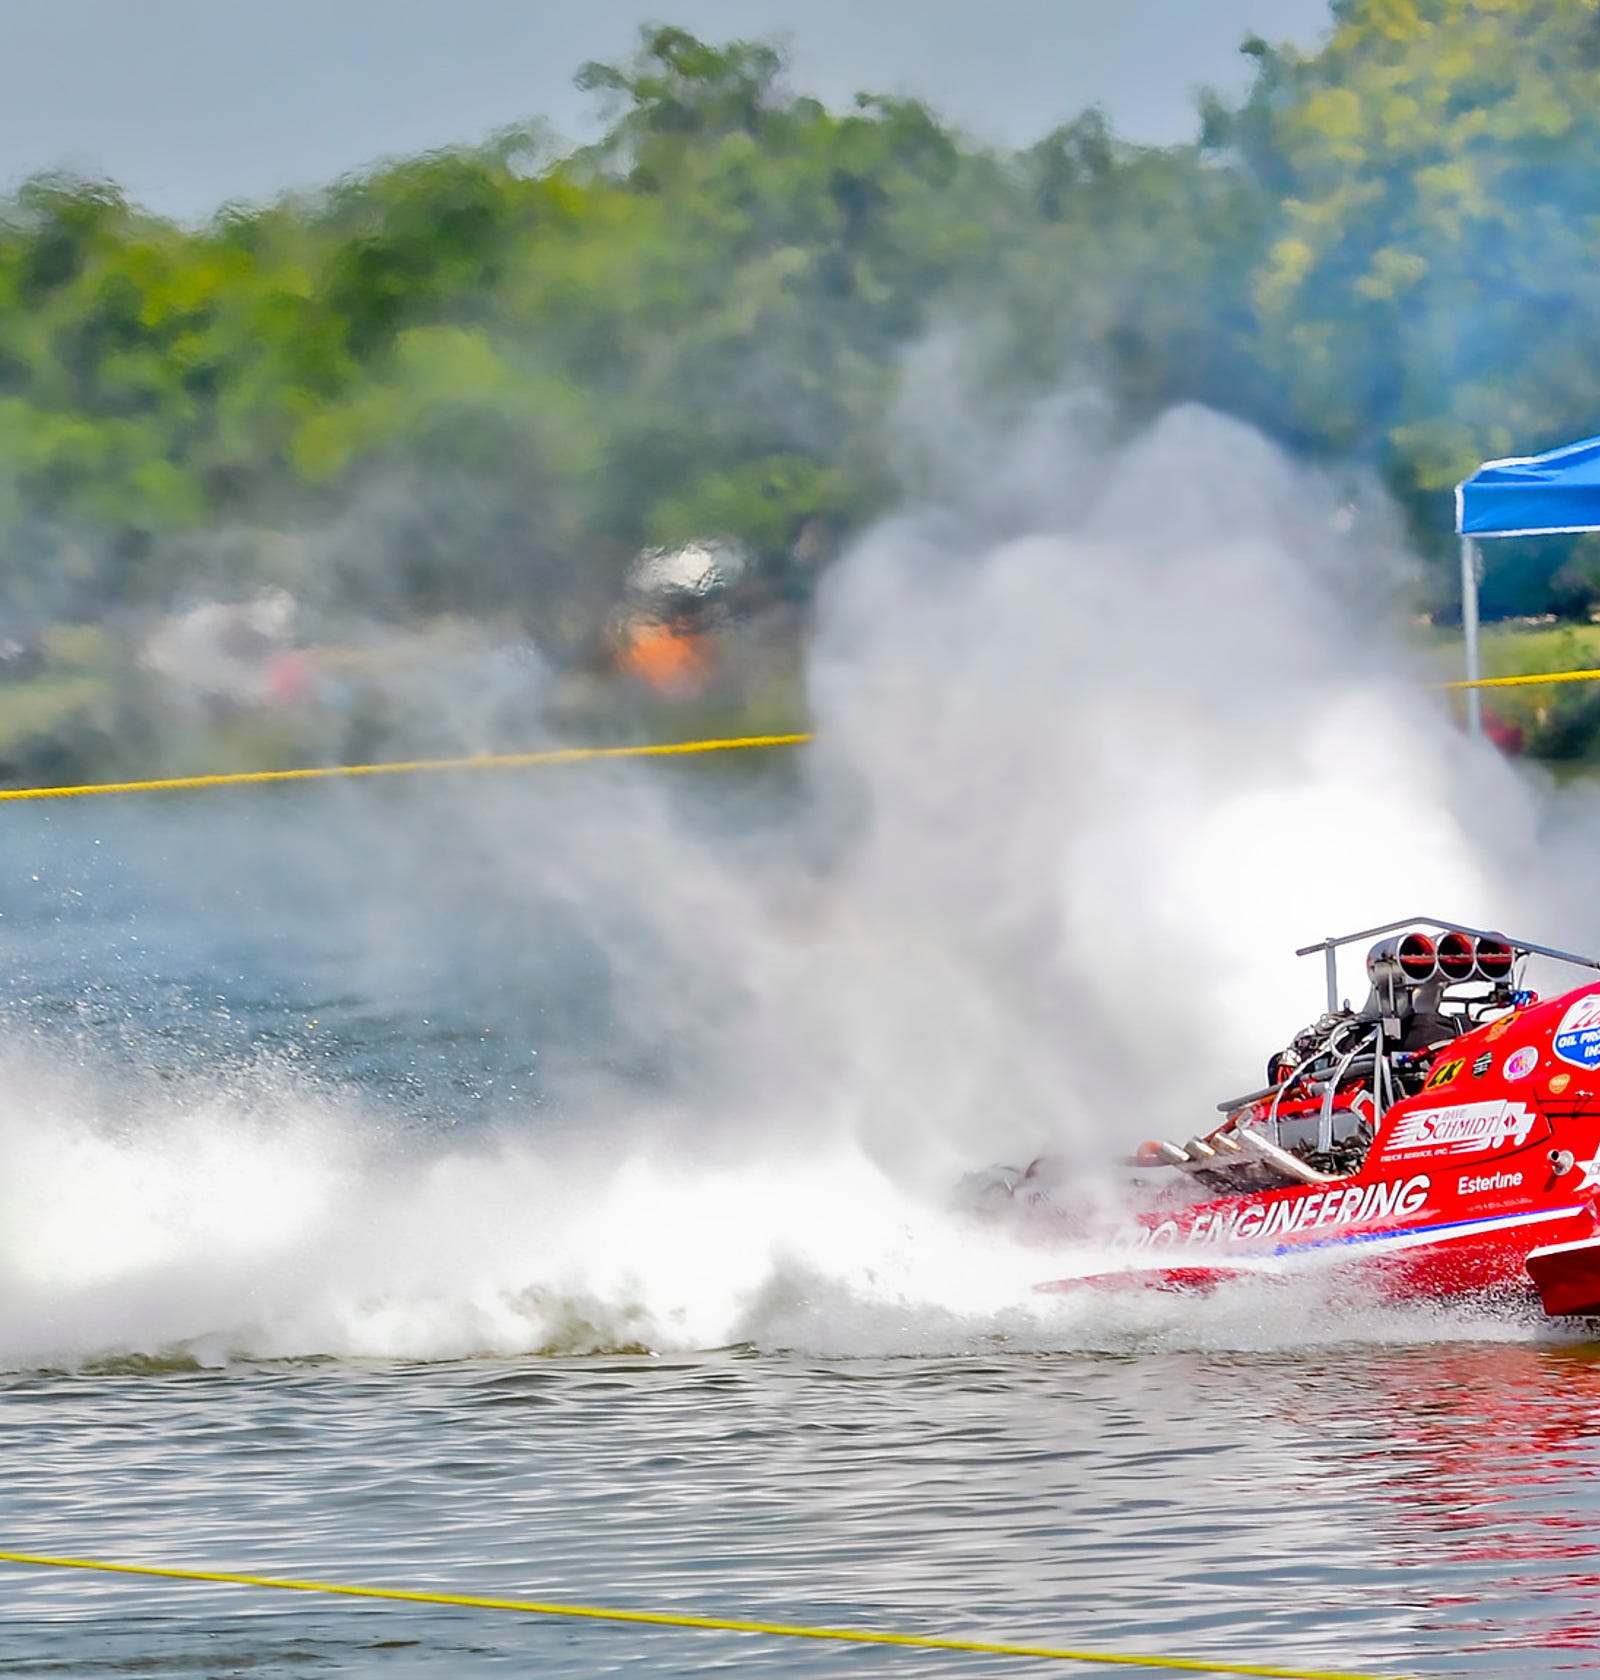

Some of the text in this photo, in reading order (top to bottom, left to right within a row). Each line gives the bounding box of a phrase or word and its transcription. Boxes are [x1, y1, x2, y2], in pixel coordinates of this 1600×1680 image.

[1558, 1035, 1577, 1048] OIL
[1457, 1171, 1523, 1195] Esterline
[1186, 1174, 1430, 1249] ENGINEERING
